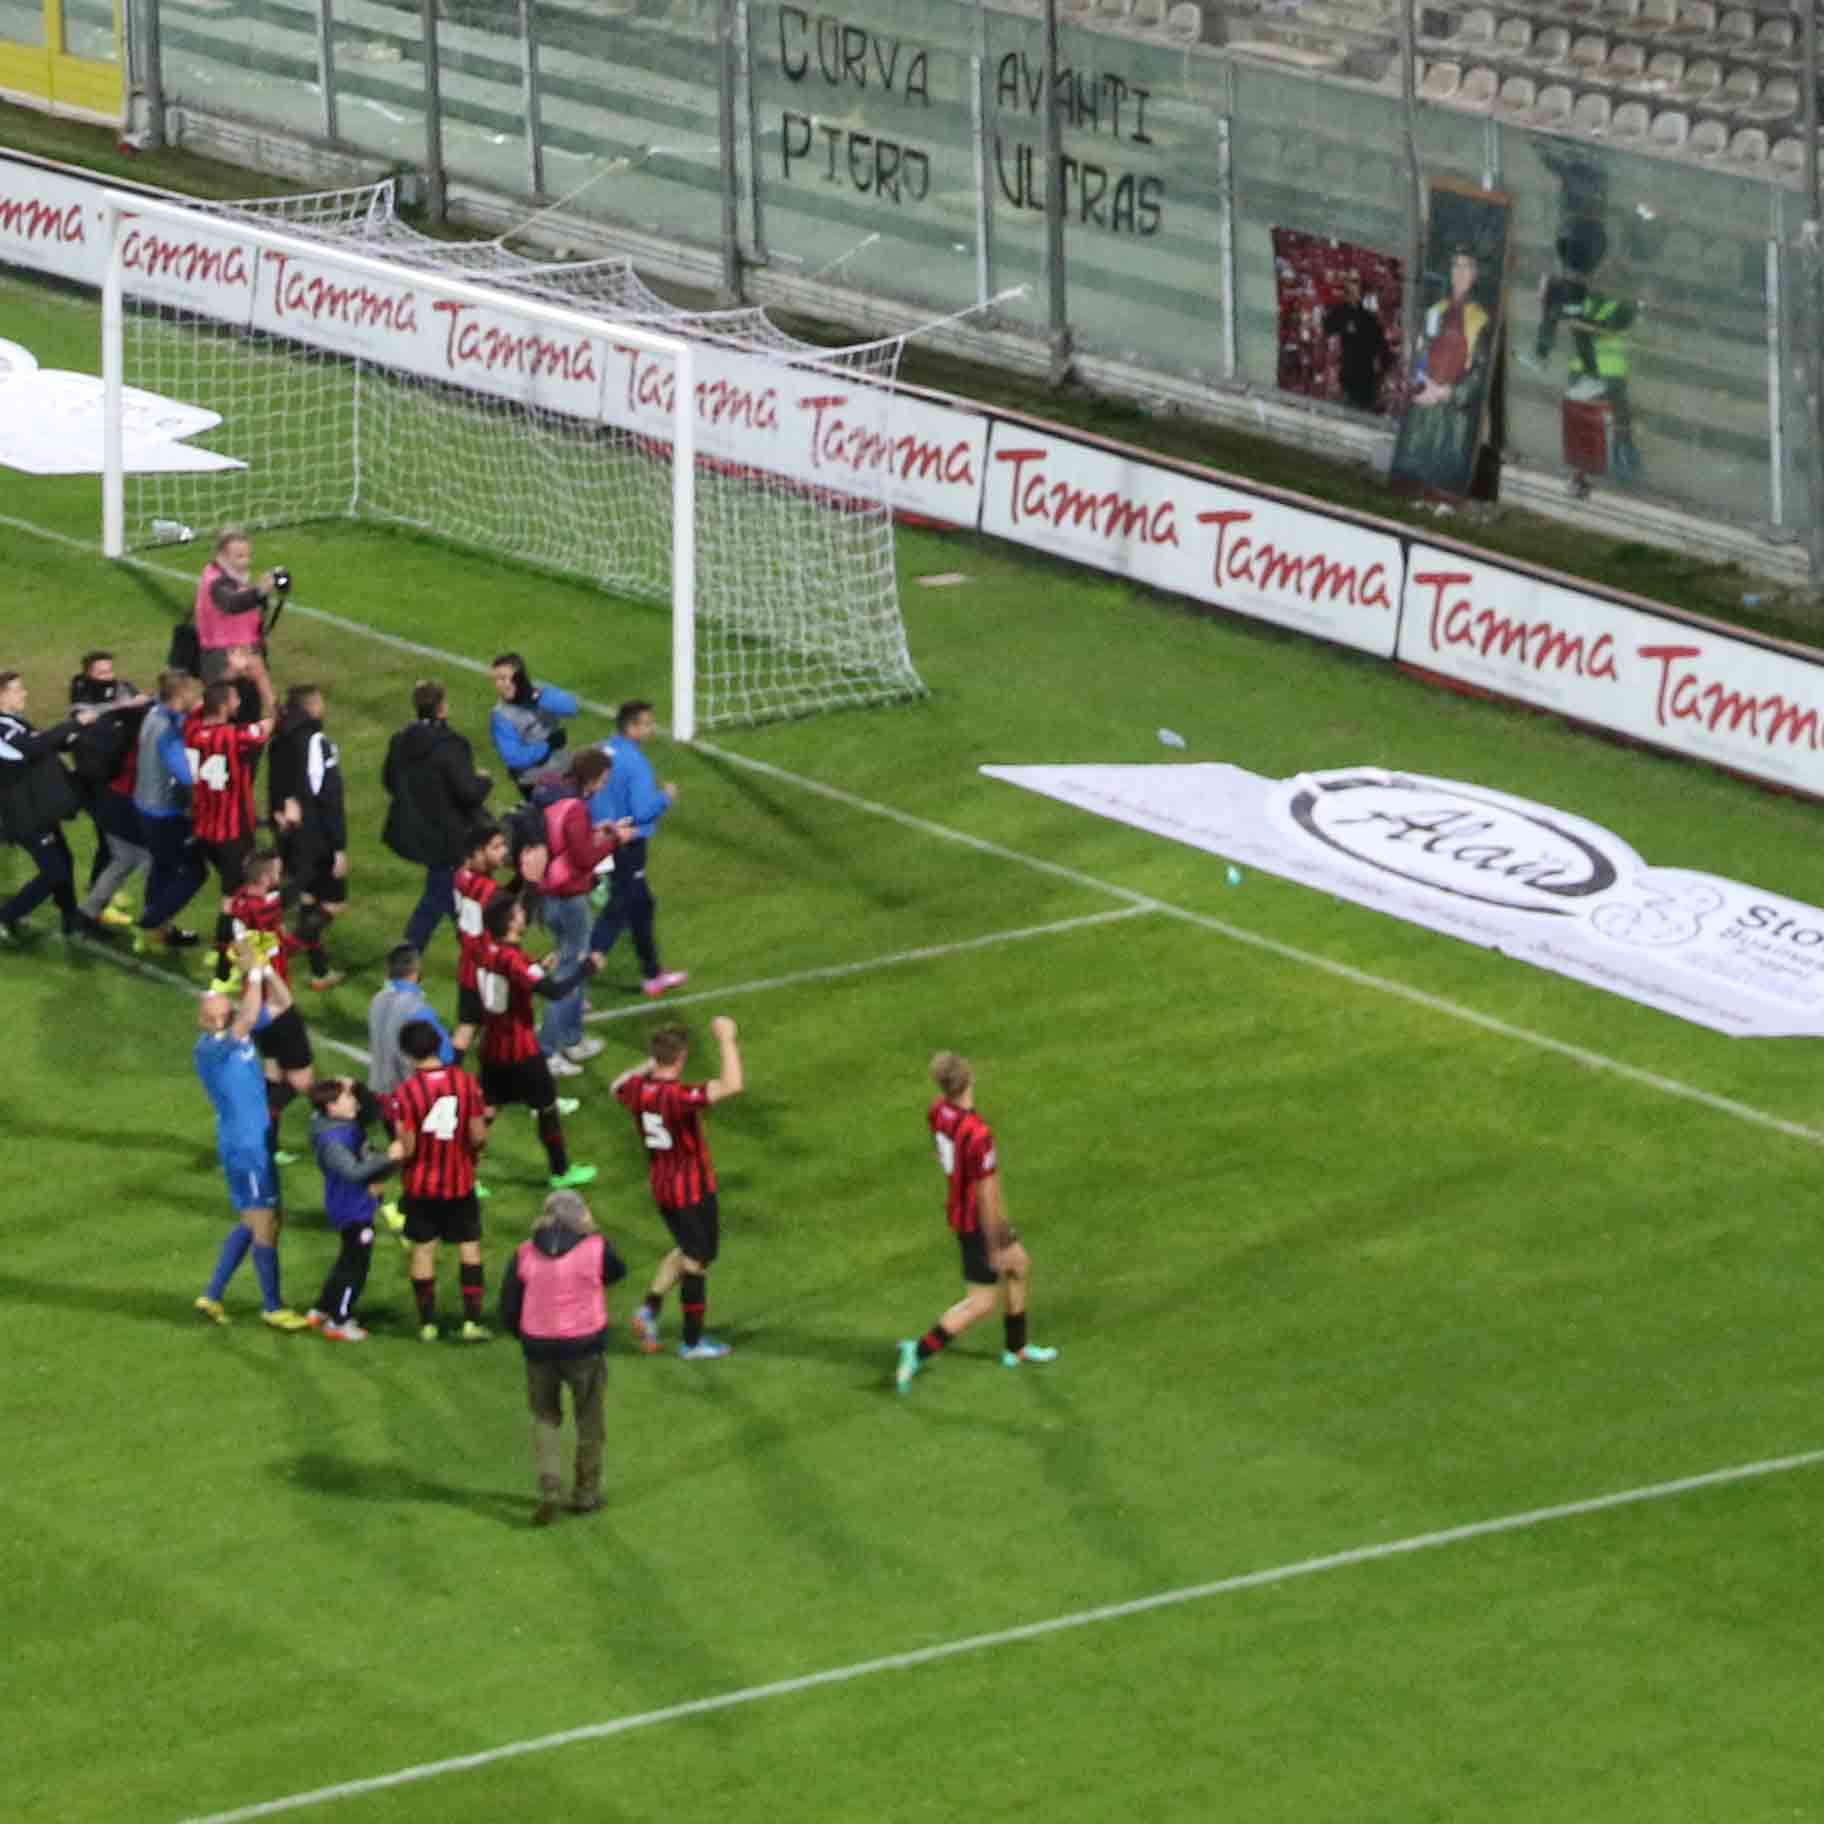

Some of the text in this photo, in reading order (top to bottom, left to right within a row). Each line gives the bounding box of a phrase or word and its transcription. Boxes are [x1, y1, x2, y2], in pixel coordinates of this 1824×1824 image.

[778, 4, 930, 108] CURVA
[996, 49, 1152, 145] AVANTI
[781, 111, 930, 205] PIERO
[994, 133, 1166, 236] ULTRAS
[266, 250, 597, 383] Tamma Tamma
[799, 395, 973, 487] Tamma
[996, 448, 1392, 610] Tamma Tamma
[1415, 573, 1617, 681] Tamma
[420, 1095, 459, 1141] 4
[640, 1110, 674, 1151] 5
